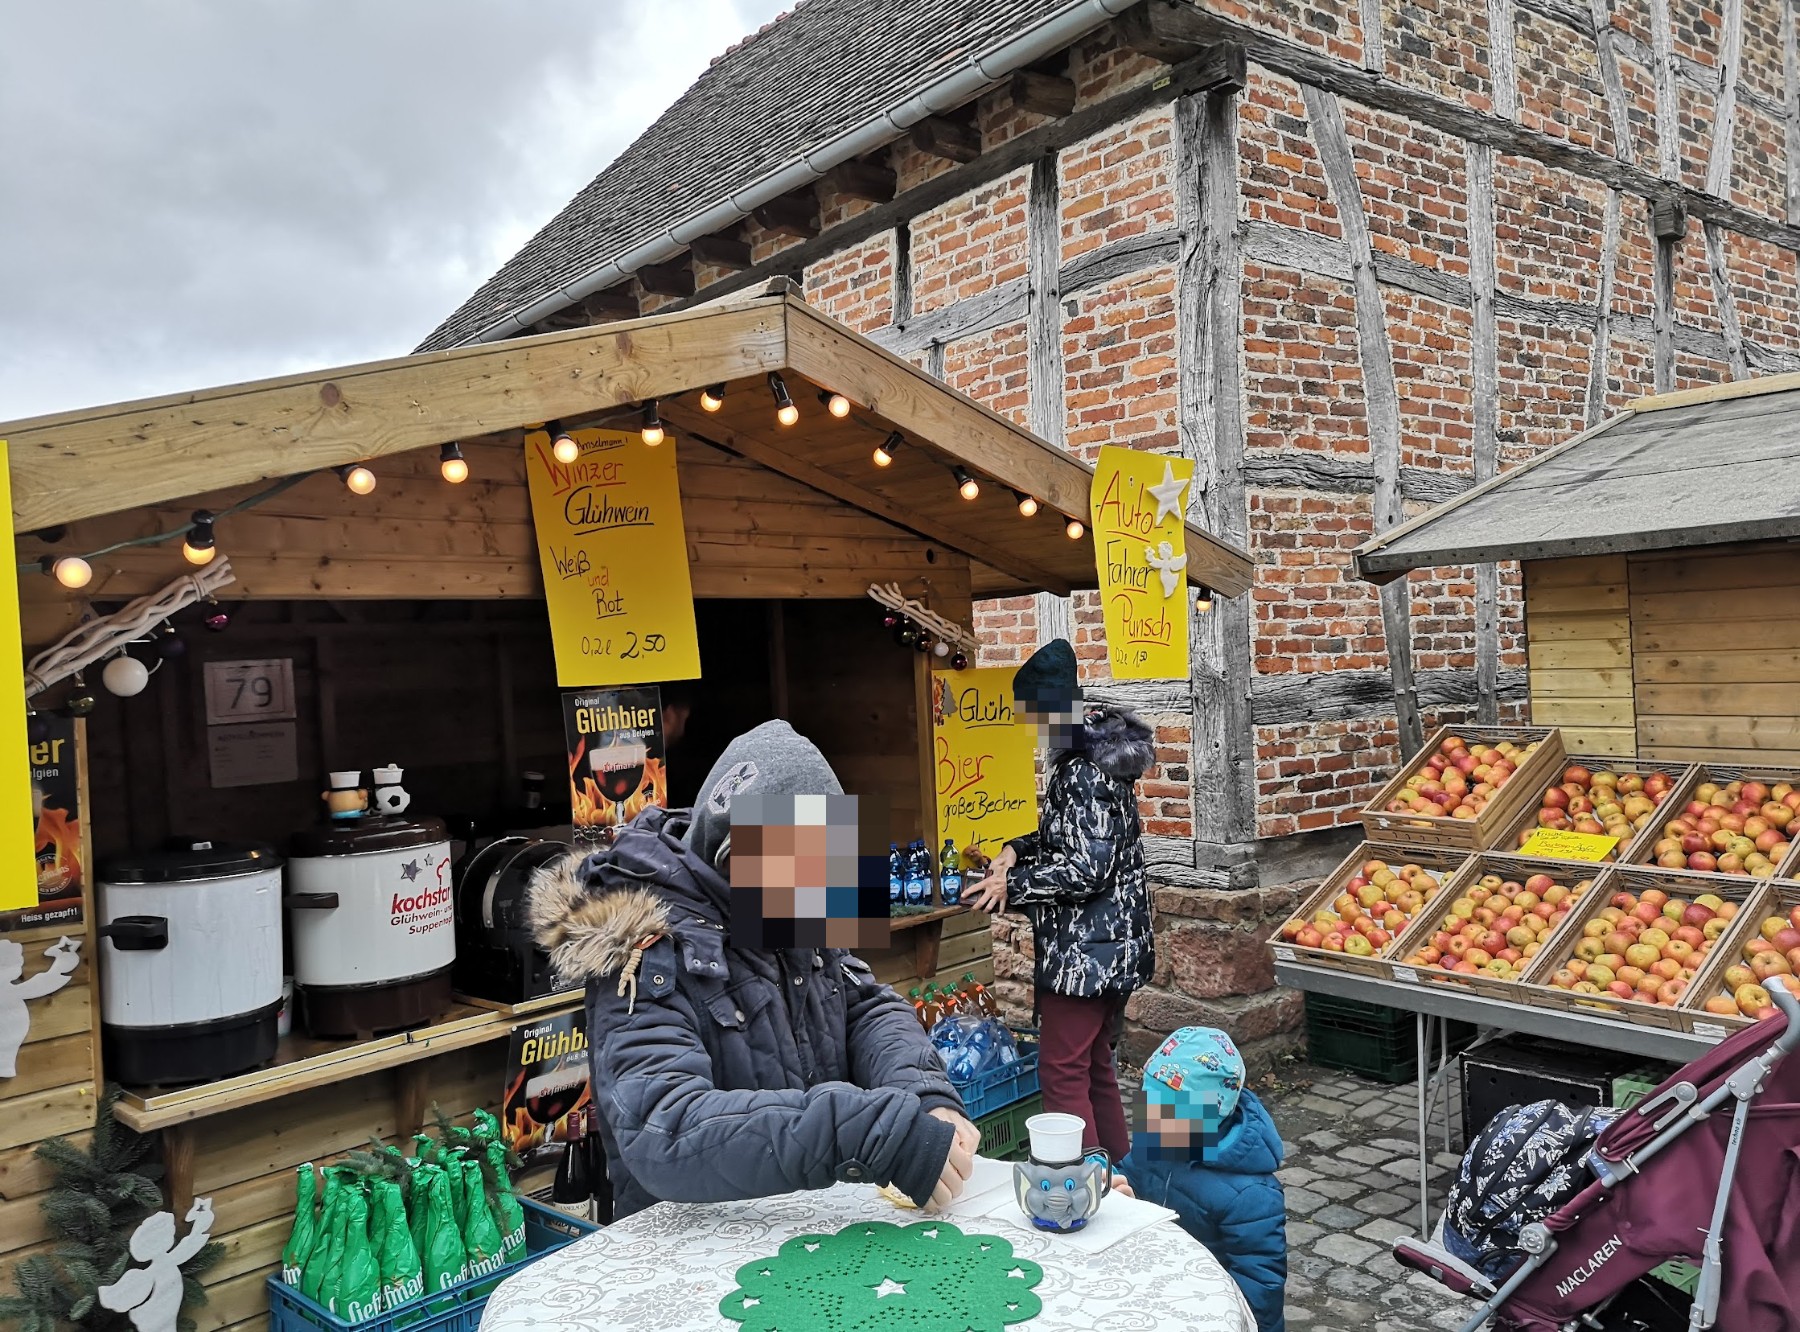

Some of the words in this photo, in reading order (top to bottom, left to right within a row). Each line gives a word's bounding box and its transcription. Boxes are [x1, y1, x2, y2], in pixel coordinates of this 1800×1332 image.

[535, 442, 624, 492] Winzer
[564, 486, 649, 526] Glühwein
[549, 546, 591, 577] Weiß
[587, 567, 609, 587] und
[1106, 539, 1155, 588] Fahrer
[592, 588, 624, 615] Rot
[1111, 593, 1171, 642] Punsch
[620, 631, 666, 660] 2,50
[225, 676, 273, 709] 79
[574, 696, 600, 708] Original
[575, 704, 656, 735] Glühbier
[619, 730, 631, 740] aus
[632, 728, 655, 740] Belgien
[30, 767, 59, 781] lgien
[936, 736, 993, 795] Bier
[967, 790, 1027, 821] Becher
[21, 910, 43, 923] Heiss
[45, 907, 78, 921] gezapft!
[391, 886, 451, 915] kochstar
[523, 1023, 553, 1039] Original
[1555, 1233, 1623, 1298] MACLAREN
